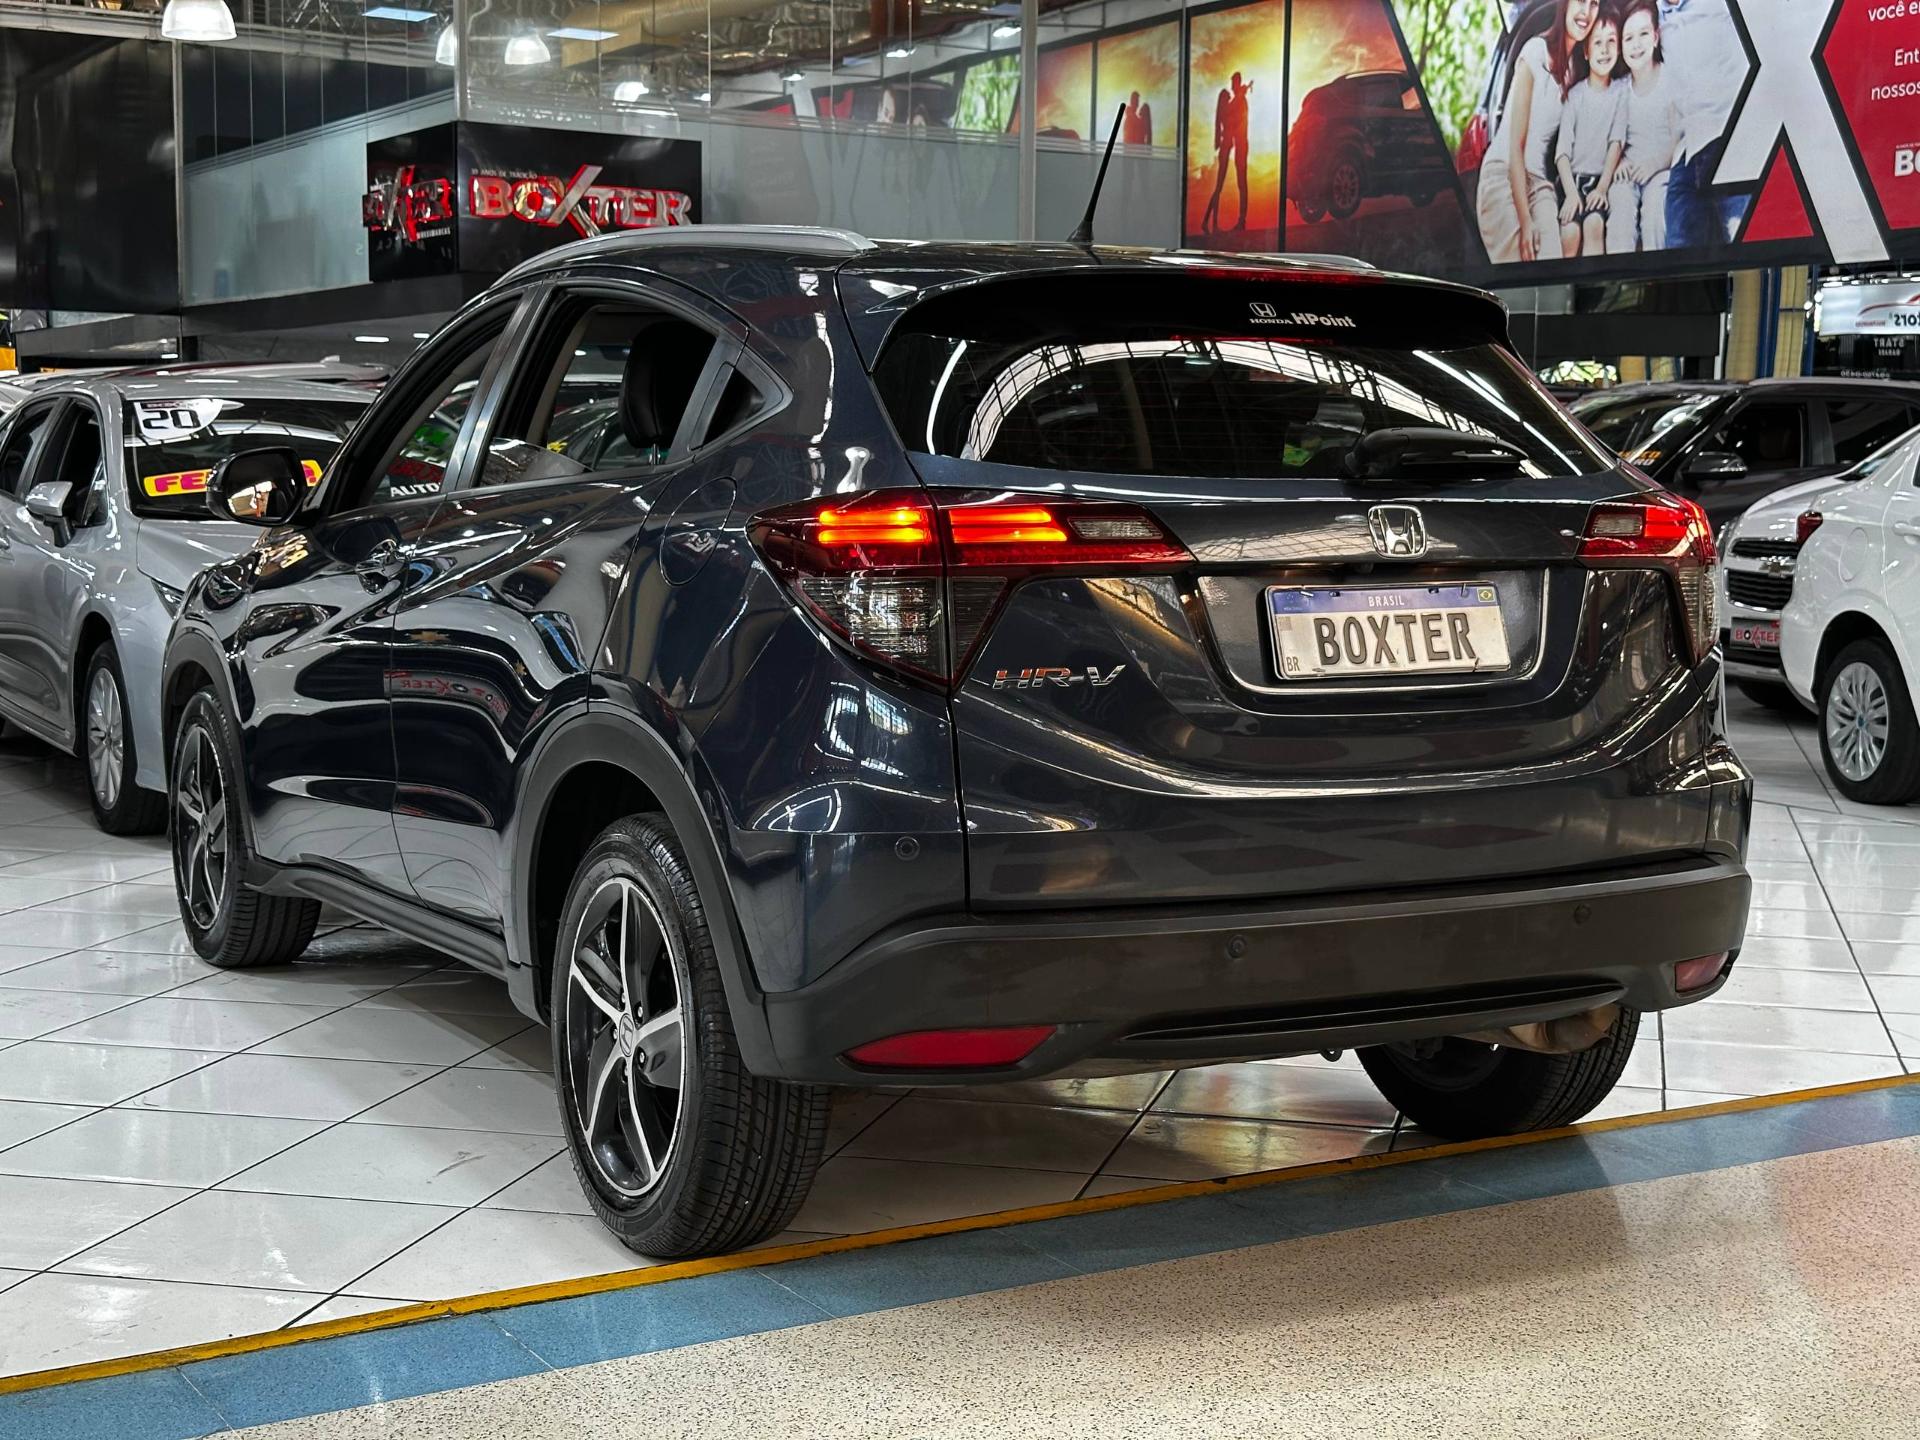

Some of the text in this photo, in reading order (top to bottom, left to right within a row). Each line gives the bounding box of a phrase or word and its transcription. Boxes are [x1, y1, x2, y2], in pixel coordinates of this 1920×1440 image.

[1868, 0, 1920, 22] você e
[469, 164, 693, 239] BOXTER
[1291, 312, 1357, 328] HPoint
[142, 409, 202, 429] 20
[390, 482, 441, 498] AUTO
[1368, 597, 1405, 607] BRASIL
[1313, 612, 1476, 665] BOXTER
[1286, 656, 1300, 672] BR
[992, 664, 1126, 690] HR-V
